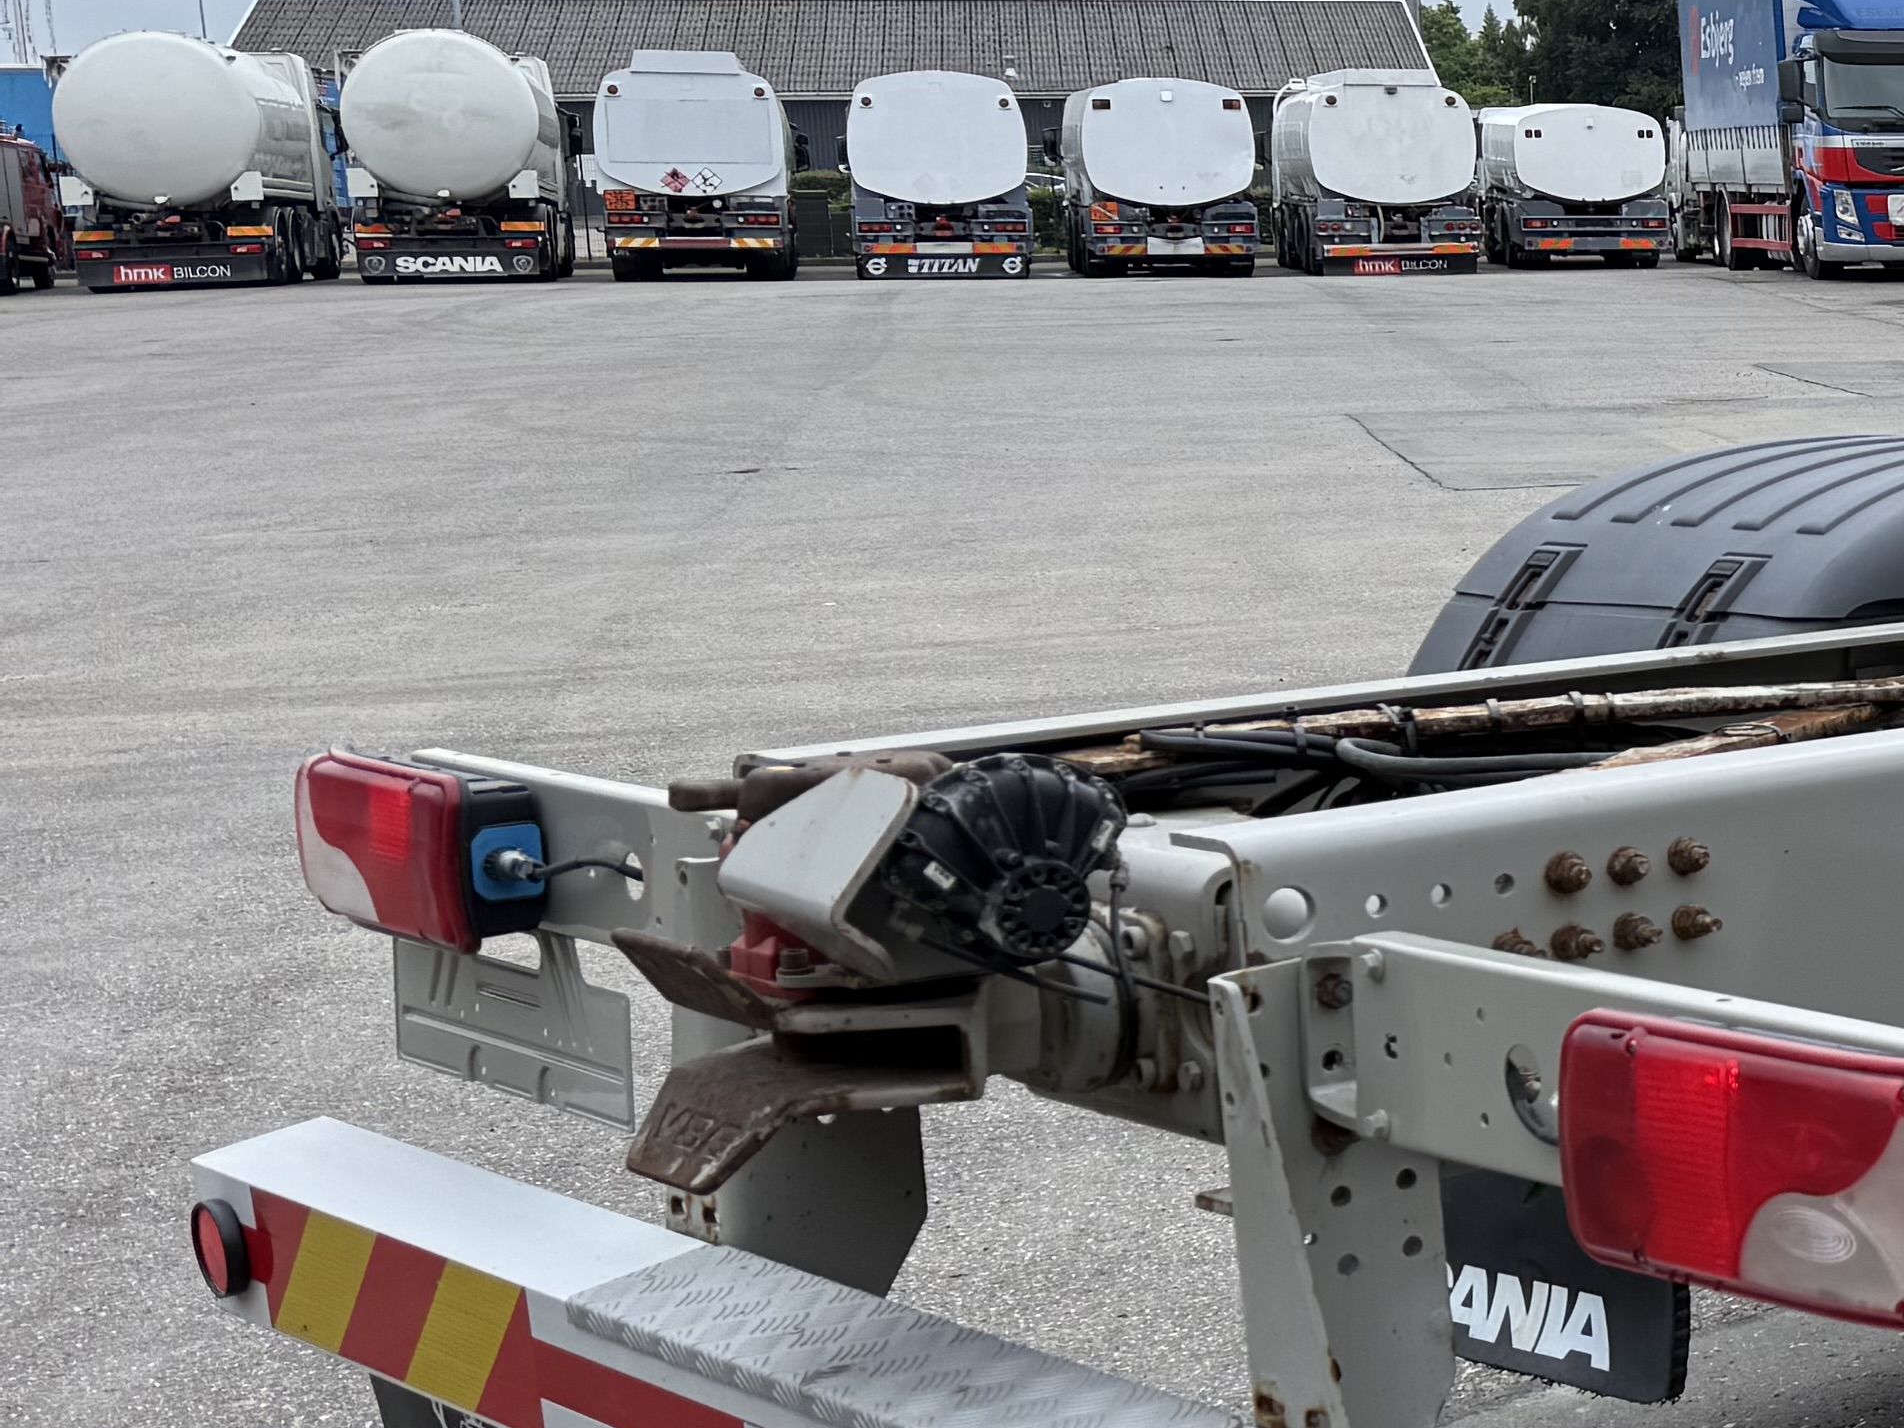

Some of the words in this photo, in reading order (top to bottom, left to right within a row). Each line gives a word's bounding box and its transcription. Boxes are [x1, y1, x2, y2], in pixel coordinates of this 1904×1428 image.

[1700, 11, 1735, 68] Esbjerg
[395, 255, 503, 273] SCANIA
[920, 258, 981, 272] TITAN
[1359, 259, 1395, 272] hmk
[1401, 259, 1447, 271] BILCON
[120, 265, 165, 282] hmk
[174, 265, 231, 279] BILCON
[1445, 1262, 1611, 1372] ANIA
